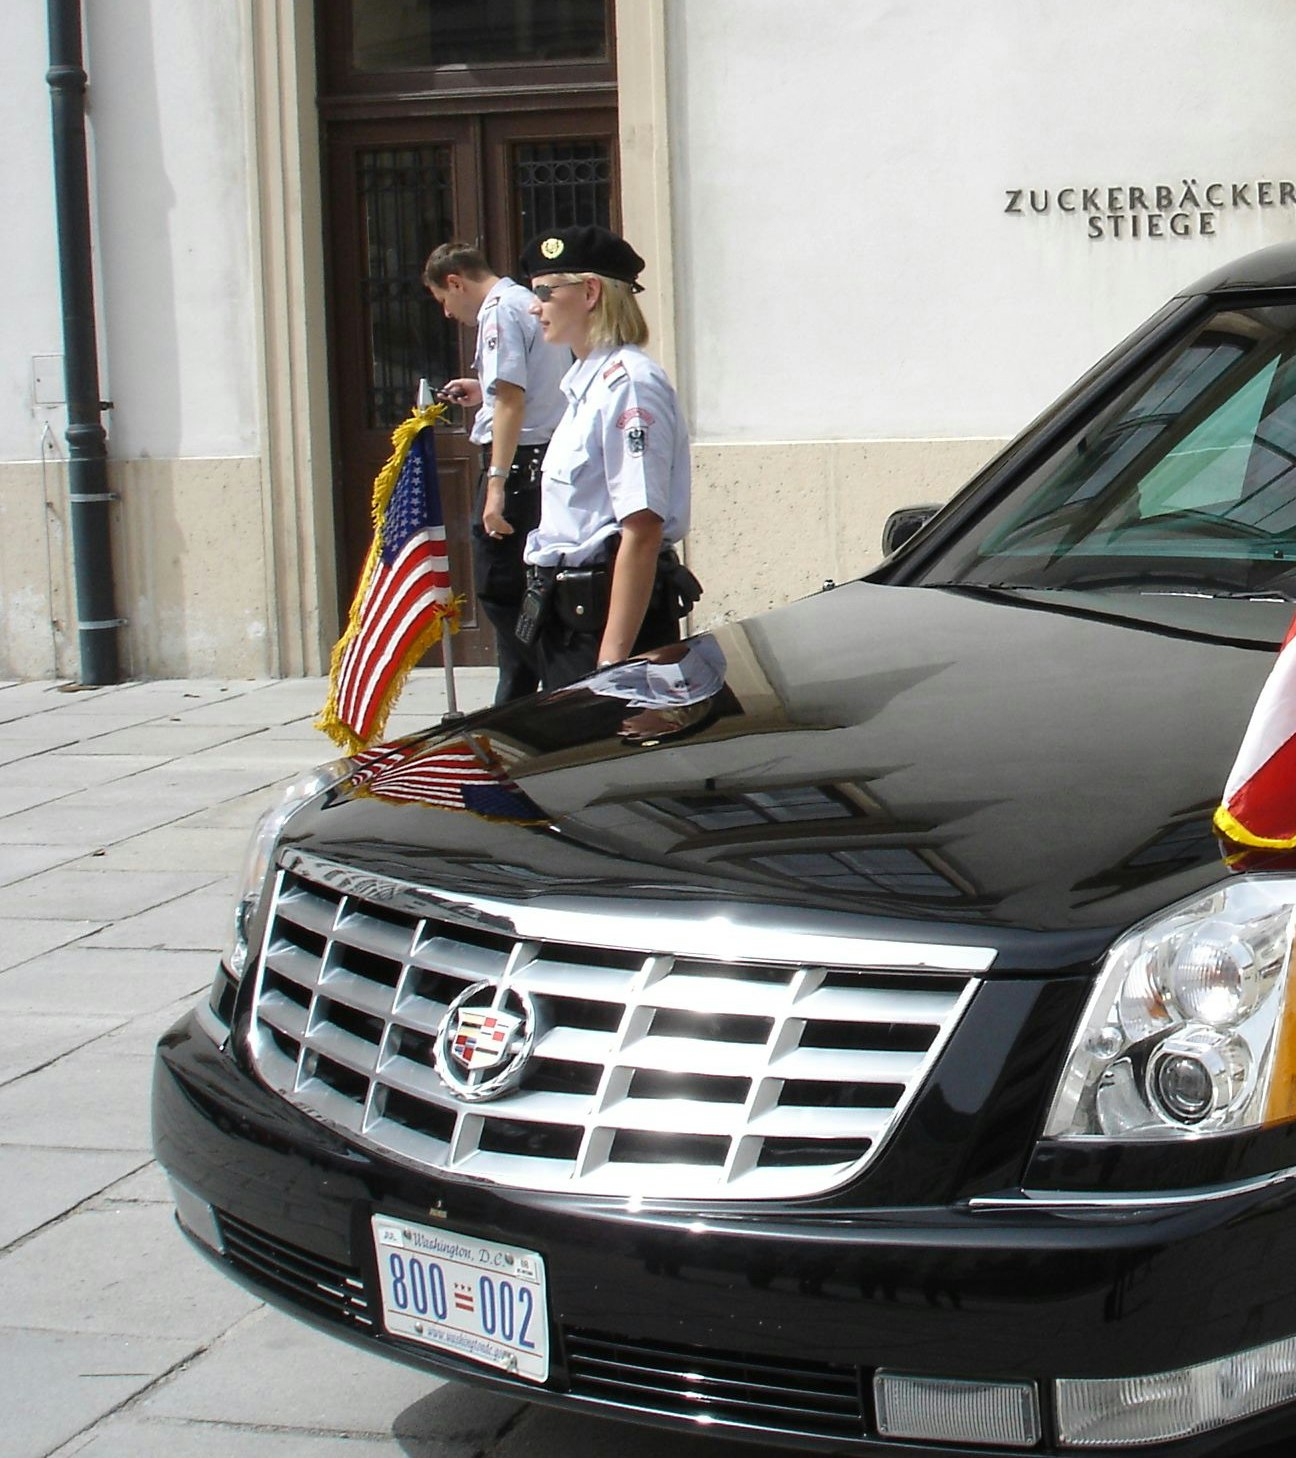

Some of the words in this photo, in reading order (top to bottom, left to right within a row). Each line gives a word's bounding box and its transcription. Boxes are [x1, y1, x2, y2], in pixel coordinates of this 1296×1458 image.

[1087, 211, 1217, 239] STIEGE
[389, 1252, 448, 1321] 800
[479, 1275, 536, 1349] 002
